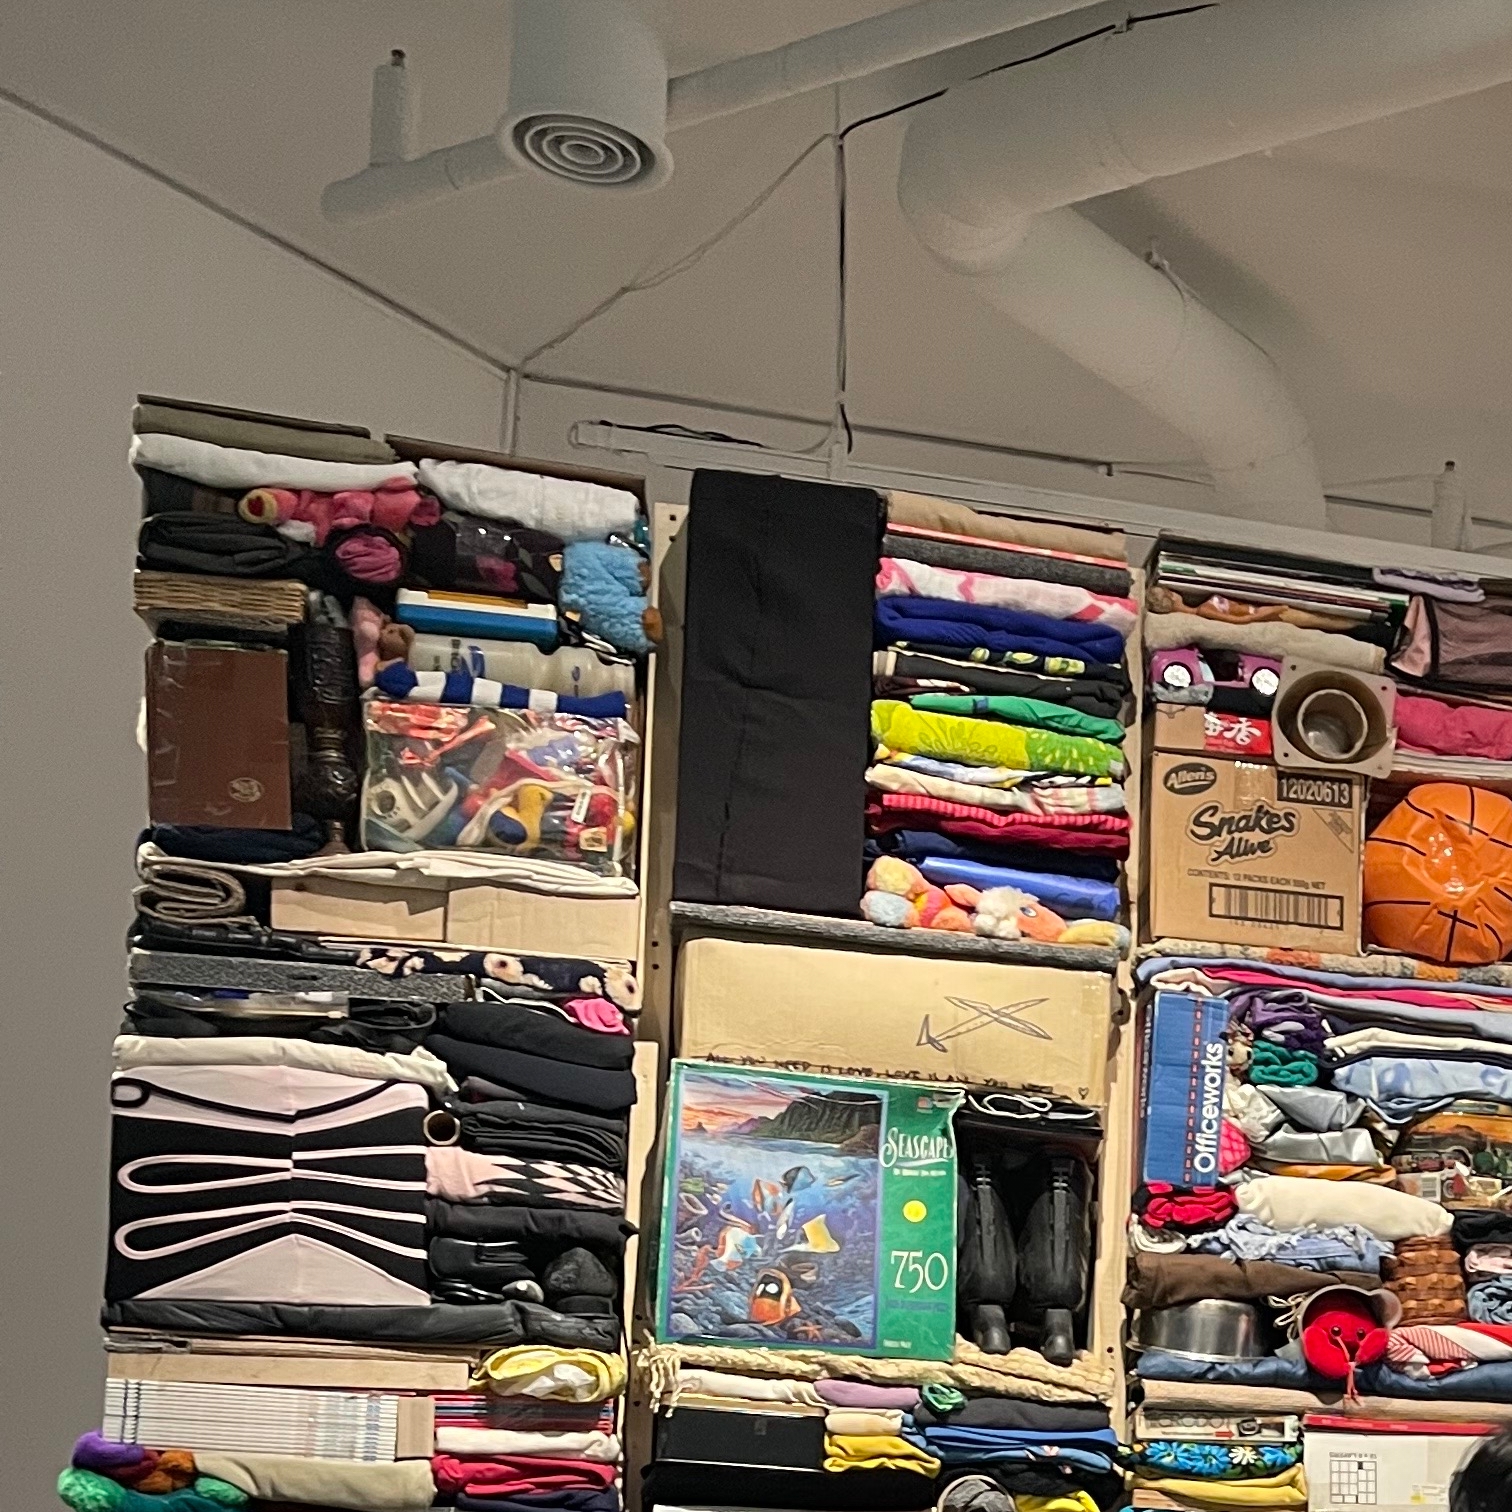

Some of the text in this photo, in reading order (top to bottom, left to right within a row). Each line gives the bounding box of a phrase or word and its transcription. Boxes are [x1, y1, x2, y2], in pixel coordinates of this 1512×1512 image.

[1167, 768, 1215, 788] Allen's
[1280, 778, 1350, 805] 12020613
[1190, 804, 1296, 842] Snakes
[1211, 836, 1273, 863] Alive
[1193, 1041, 1224, 1174] Officeworks
[890, 1250, 949, 1294] 750
